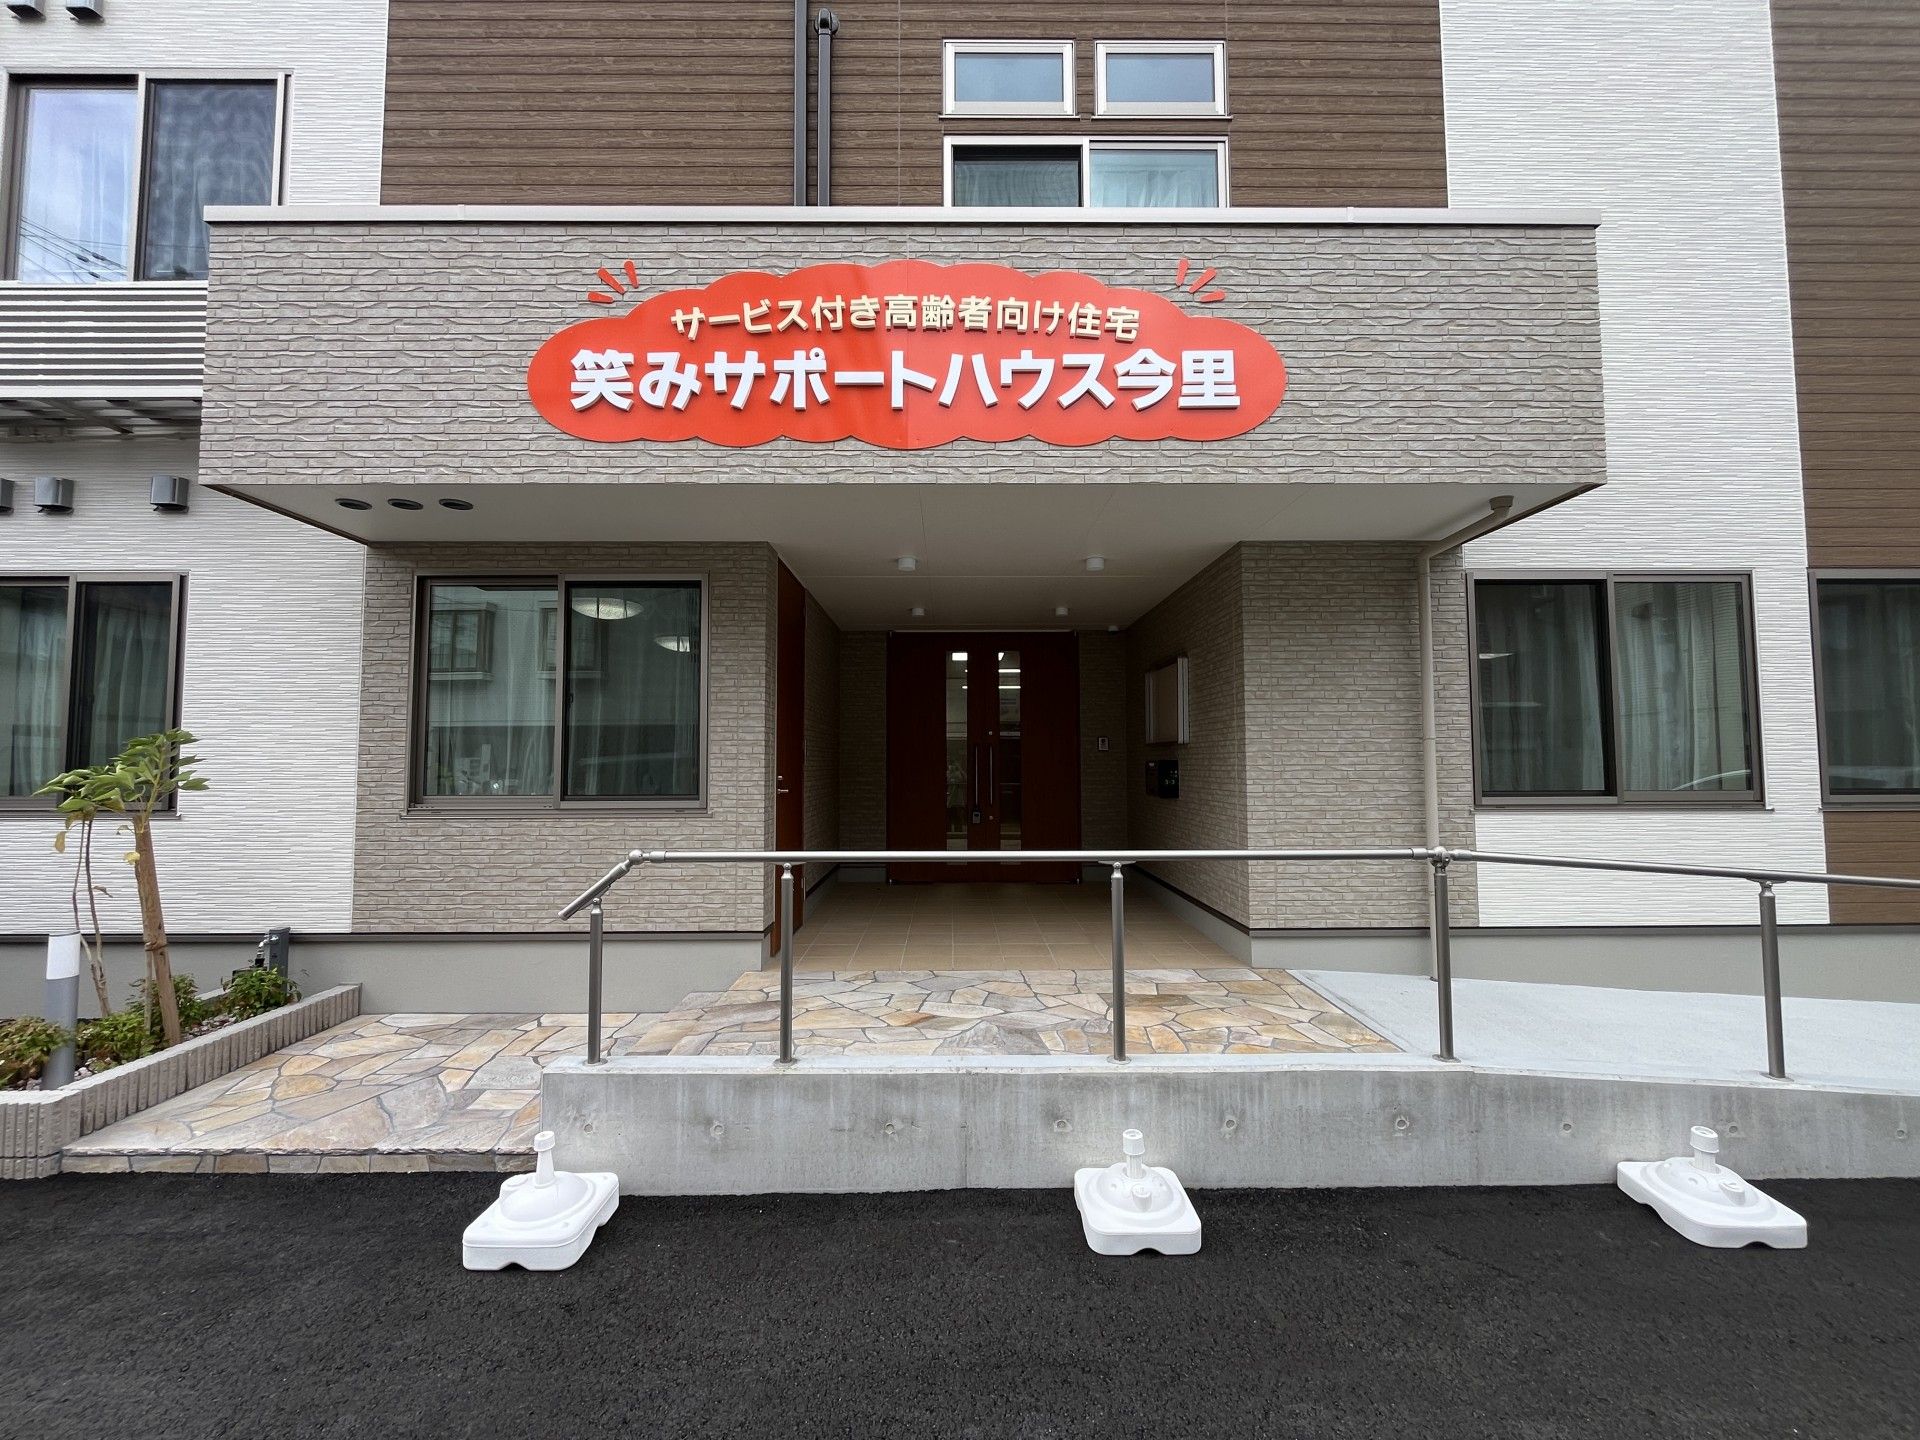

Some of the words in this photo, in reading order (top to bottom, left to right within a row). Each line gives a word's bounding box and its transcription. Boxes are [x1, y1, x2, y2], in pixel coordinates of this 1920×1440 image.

[670, 294, 1140, 342] サービス付き高齢者向け住宅
[570, 348, 1241, 411] 笑みサポートハウス今里
